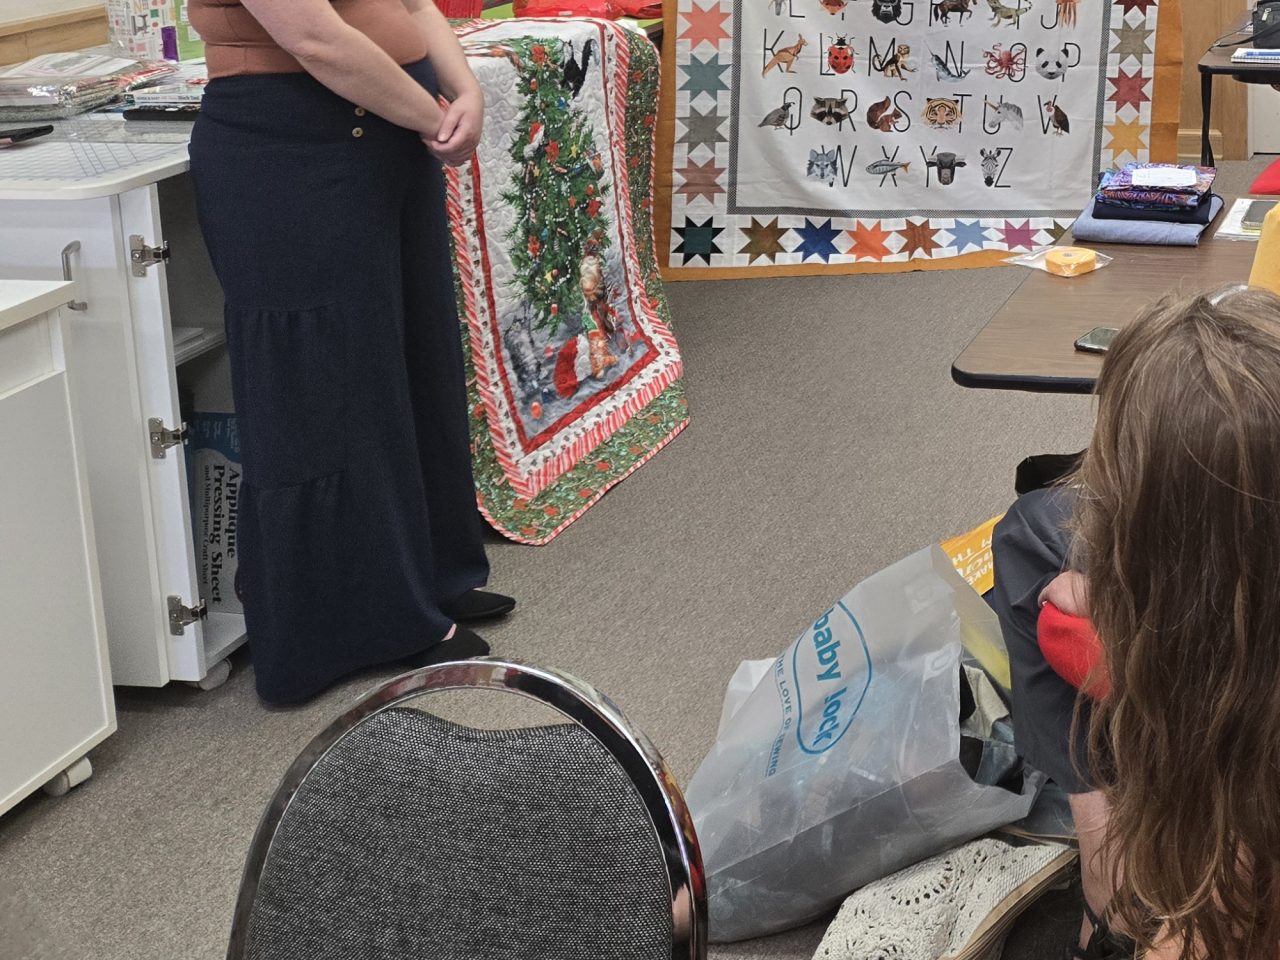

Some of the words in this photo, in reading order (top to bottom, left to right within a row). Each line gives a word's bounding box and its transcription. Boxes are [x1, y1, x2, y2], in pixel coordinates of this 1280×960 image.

[763, 28, 785, 73] K
[819, 32, 836, 76] L
[868, 36, 896, 76] M
[944, 40, 964, 78] N
[1061, 42, 1081, 82] P
[783, 86, 802, 136] Q
[838, 89, 857, 132] R
[893, 90, 912, 133] S
[952, 93, 972, 134] T
[982, 94, 1002, 135] U
[1037, 94, 1057, 135] V
[879, 145, 899, 188] X
[920, 145, 937, 188] Y
[994, 147, 1013, 188] Z
[209, 465, 226, 545] Pressing
[211, 551, 223, 605] Sheet
[813, 607, 842, 681] baby
[779, 680, 793, 714] LOVE
[812, 686, 848, 747] lock
